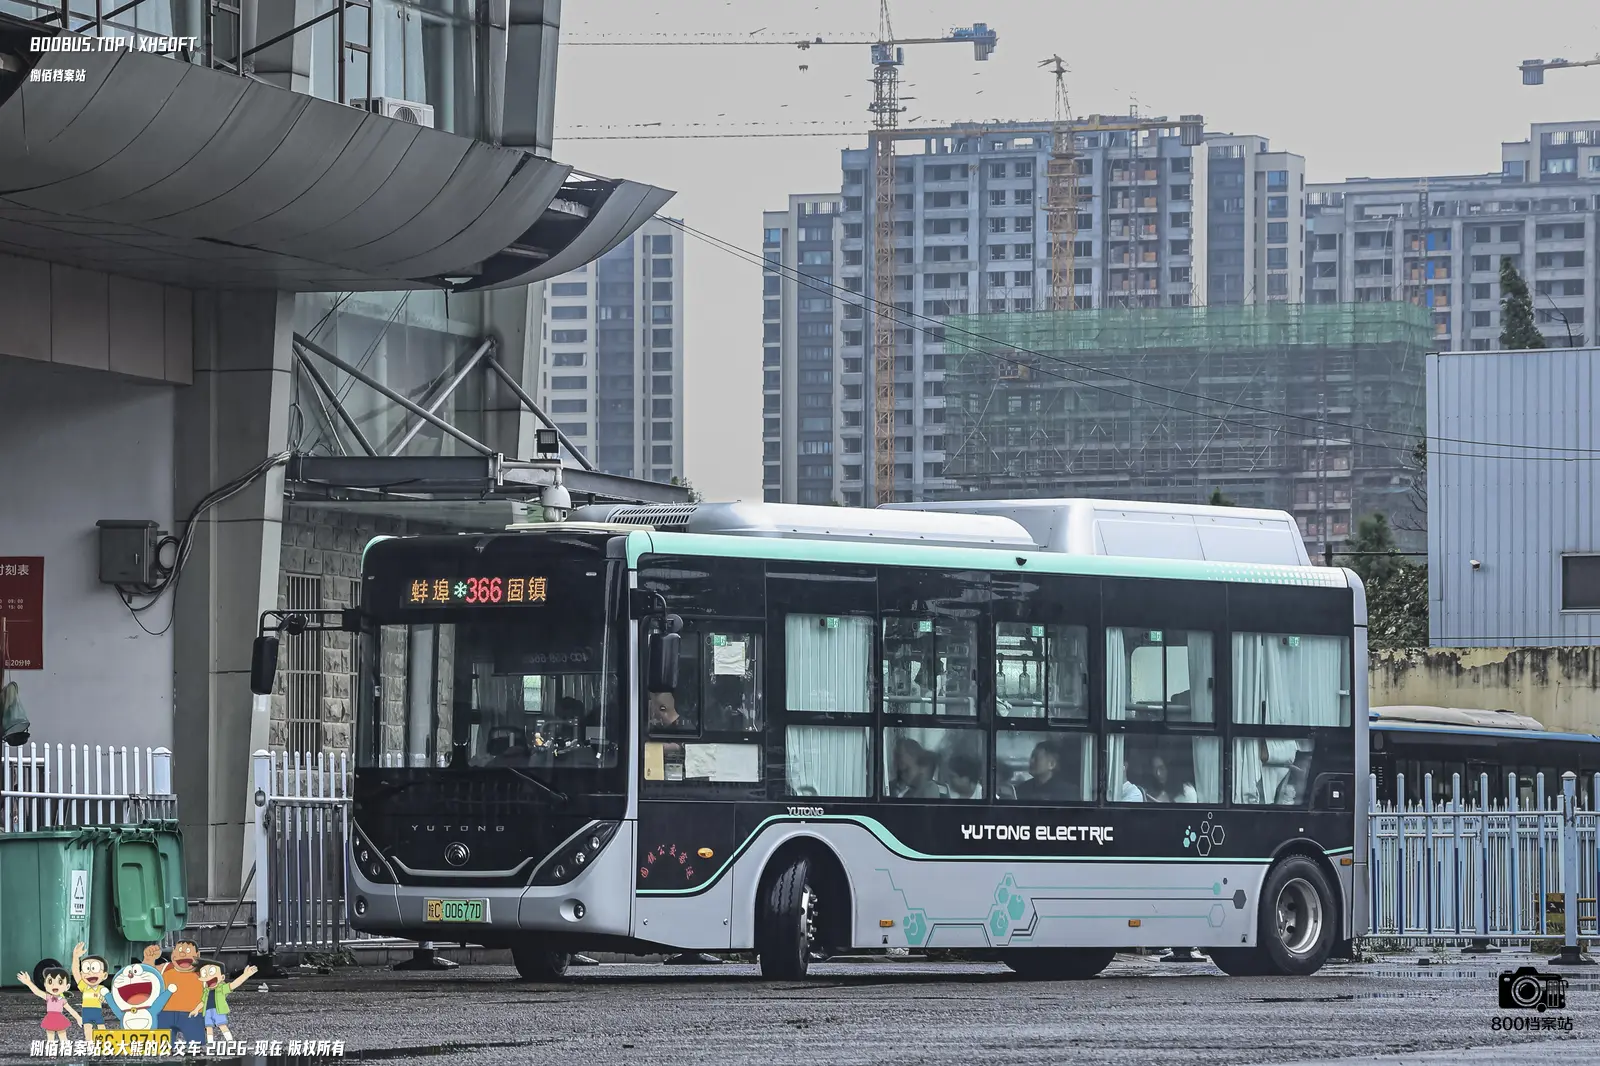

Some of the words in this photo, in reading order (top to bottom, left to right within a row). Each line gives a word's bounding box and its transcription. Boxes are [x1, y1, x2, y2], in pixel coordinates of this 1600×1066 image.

[410, 579, 450, 604] 蚌埠
[465, 577, 502, 603] 366
[507, 576, 547, 602] 固镇
[787, 806, 824, 816] YUTONG
[411, 824, 505, 832] YUTONG
[961, 824, 1030, 841] YUTONG
